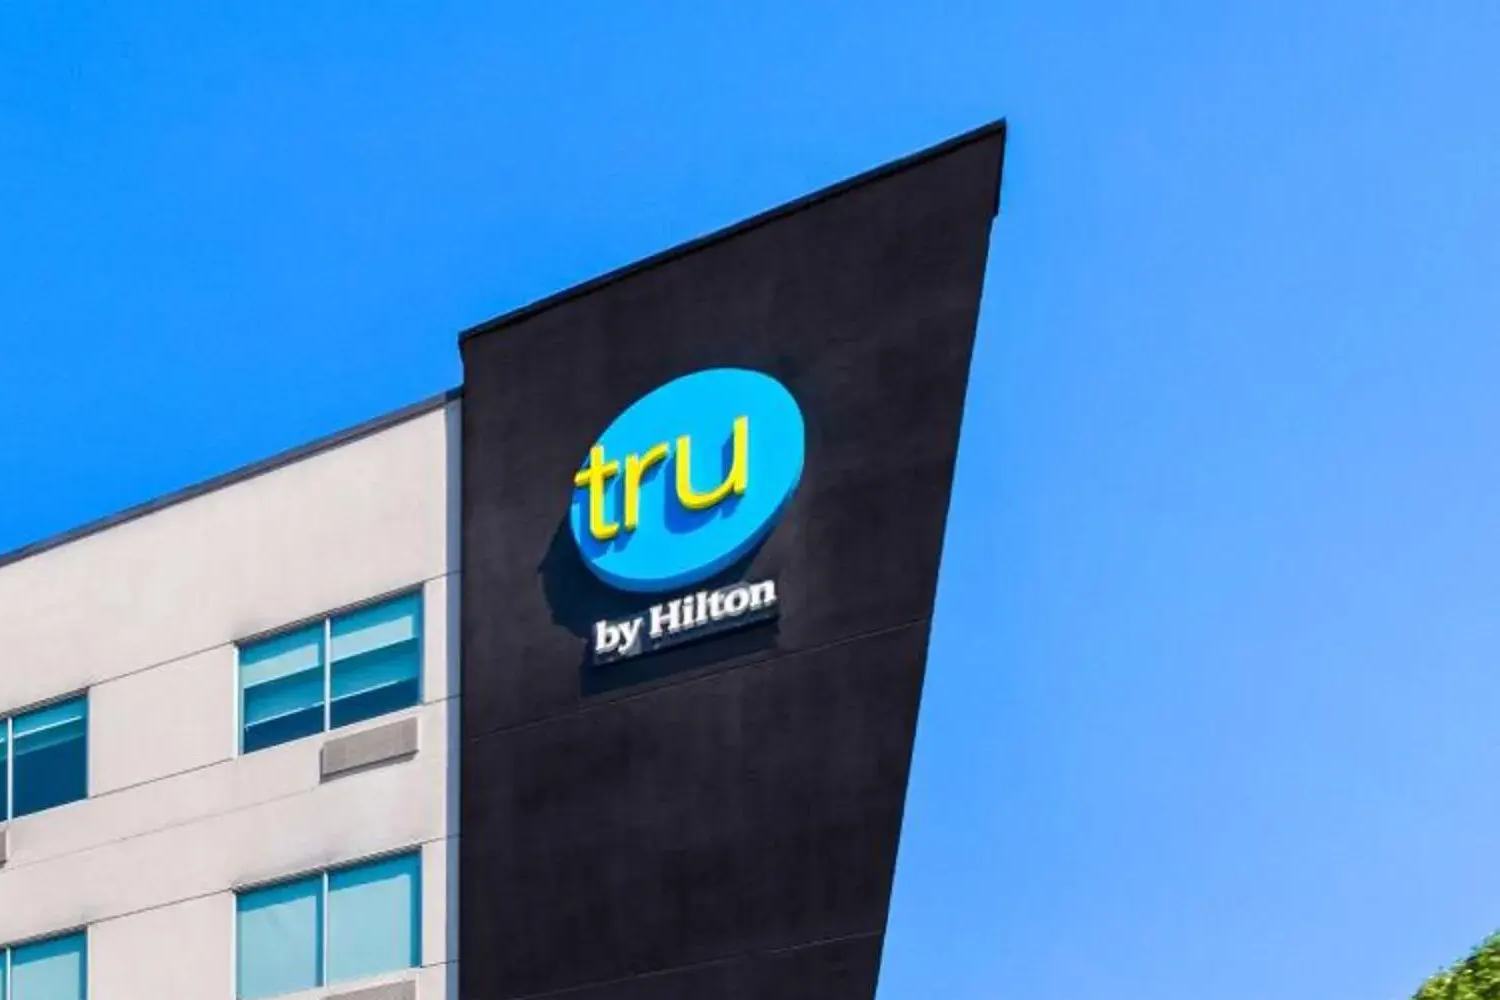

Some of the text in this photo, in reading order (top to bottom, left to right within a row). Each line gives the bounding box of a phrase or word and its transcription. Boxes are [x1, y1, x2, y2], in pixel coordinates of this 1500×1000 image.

[573, 415, 749, 541] tru
[594, 579, 778, 655] by Hilton
